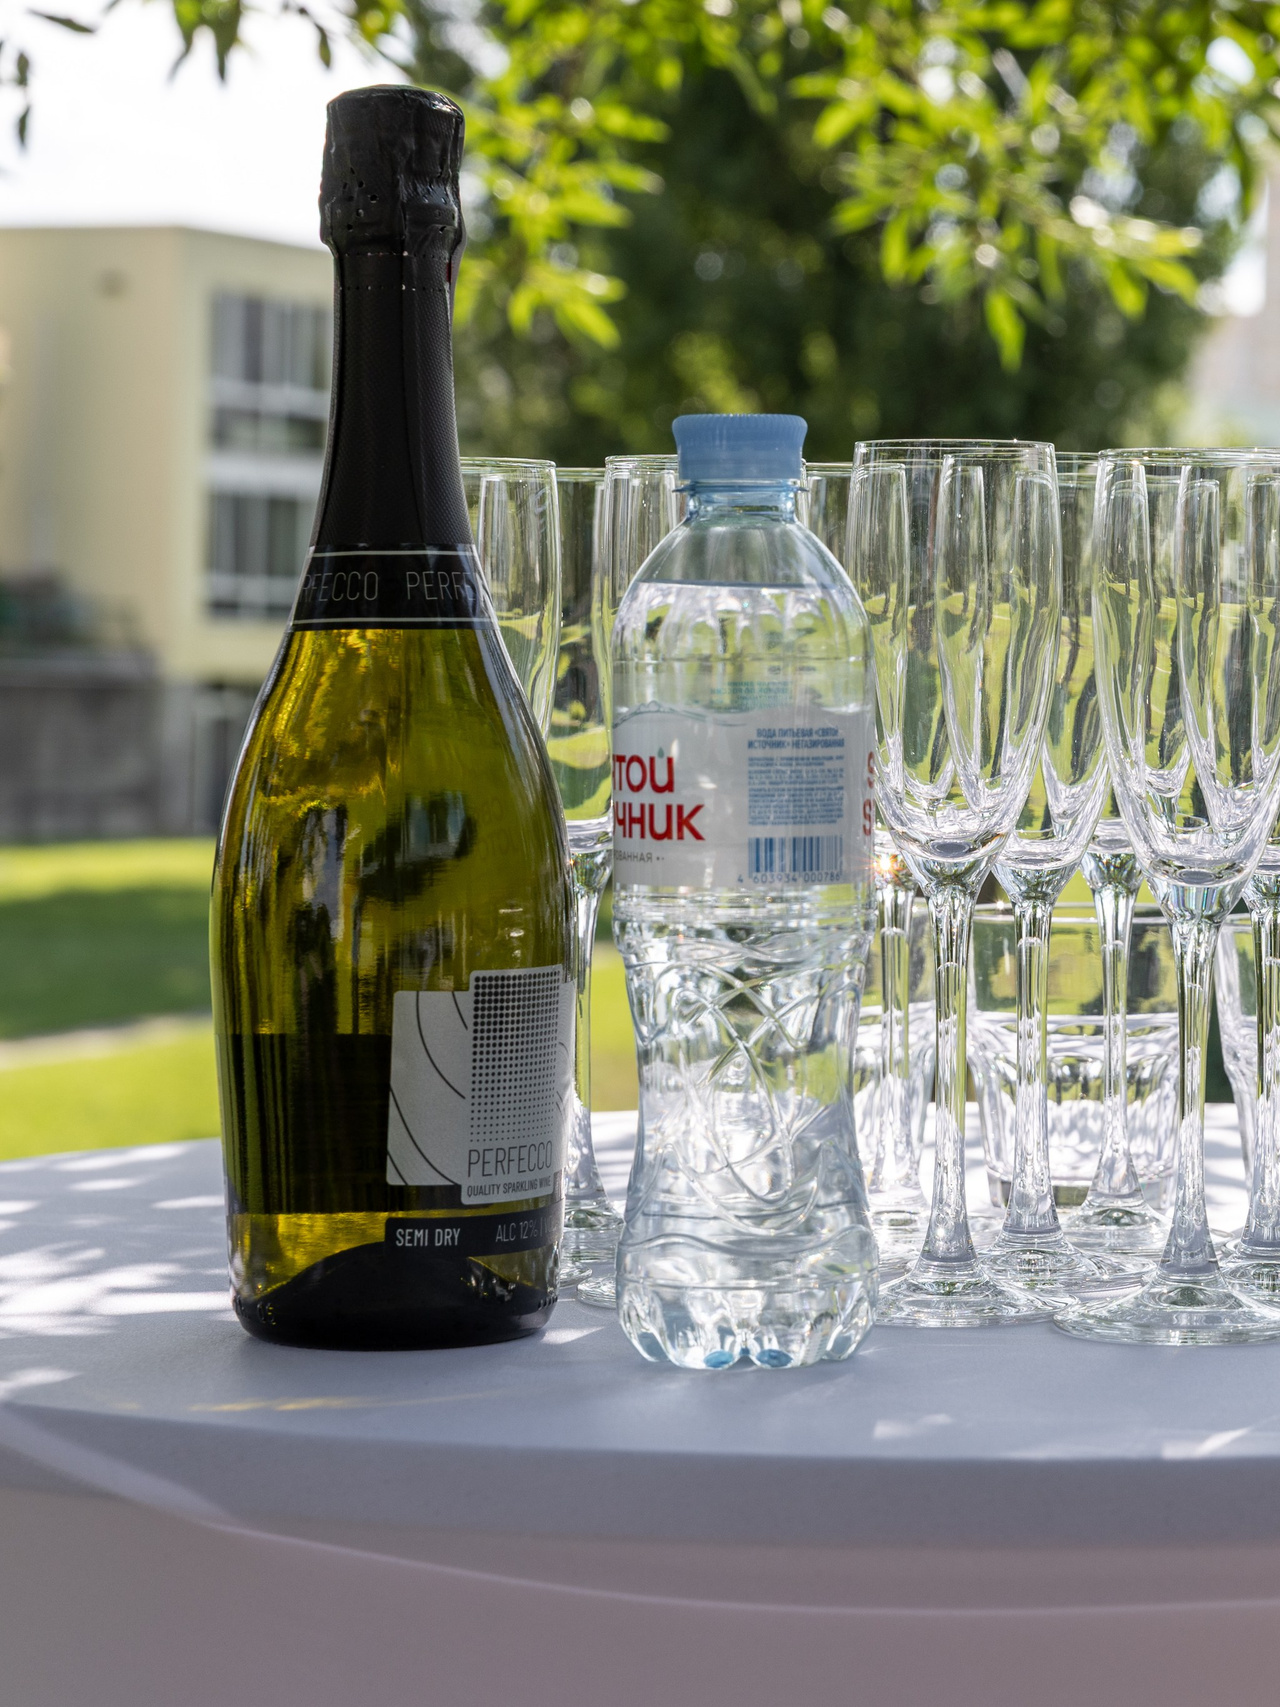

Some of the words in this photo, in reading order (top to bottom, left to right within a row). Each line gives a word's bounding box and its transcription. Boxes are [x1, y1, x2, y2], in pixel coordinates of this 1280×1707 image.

[612, 747, 674, 794] ТОЙ
[612, 801, 706, 841] ЧНИК
[753, 872, 798, 884] 603934
[803, 871, 841, 883] 000786
[467, 1140, 553, 1178] PERFECCO
[466, 1183, 501, 1198] QUALITY
[502, 1179, 539, 1194] SPARKLING
[395, 1228, 428, 1247] SEMI
[434, 1228, 461, 1247] DRY
[495, 1222, 517, 1243] ALC
[519, 1218, 538, 1240] 12%
